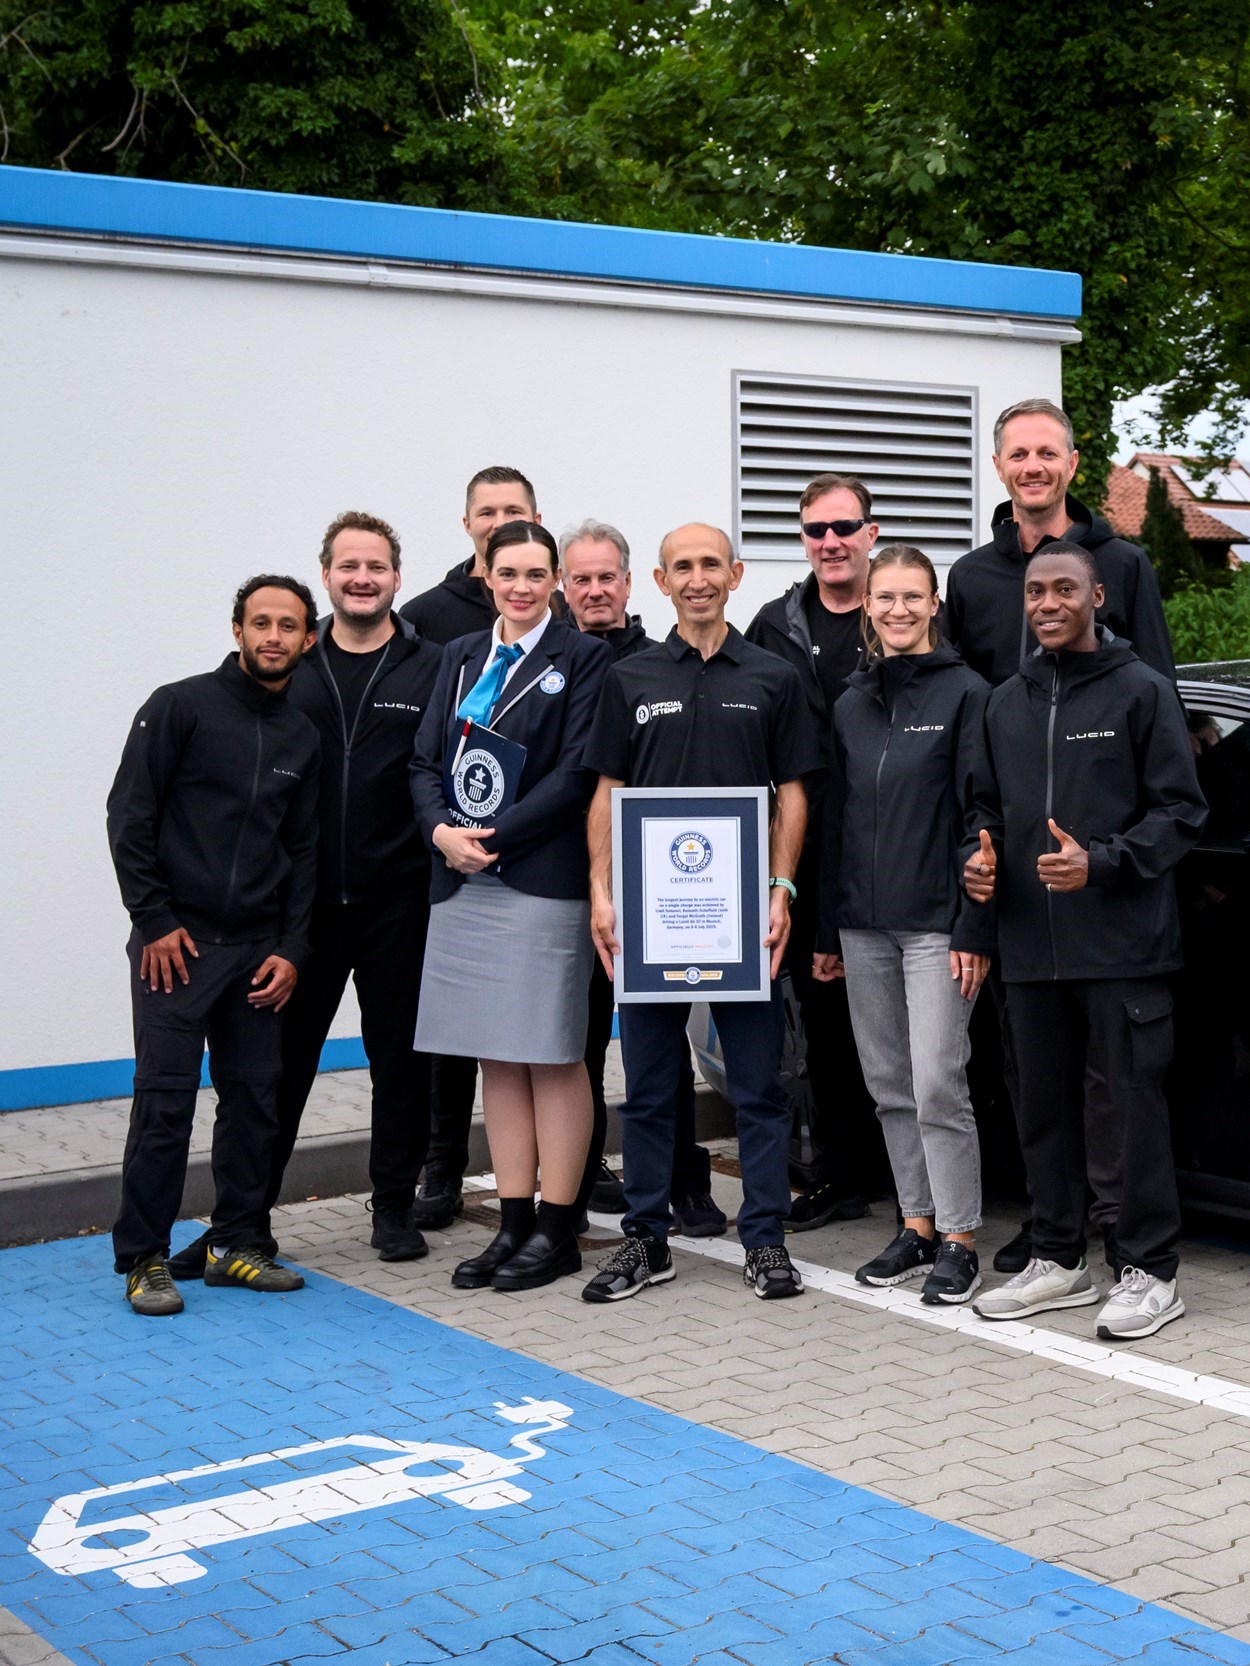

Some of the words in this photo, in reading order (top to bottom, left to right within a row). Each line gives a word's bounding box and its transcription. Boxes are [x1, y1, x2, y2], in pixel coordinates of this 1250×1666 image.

[373, 702, 420, 712] LUCID
[650, 700, 683, 710] OFFICIAL
[722, 702, 758, 711] LUCID
[652, 706, 683, 717] ATTEMPT
[1066, 730, 1115, 741] LUCID
[465, 754, 499, 779] GUINNESS
[456, 771, 468, 805] WORLD
[468, 787, 500, 813] RECORDS
[675, 833, 707, 846] GUINNESS
[671, 850, 687, 871] WORLD
[688, 849, 711, 872] RECORDS
